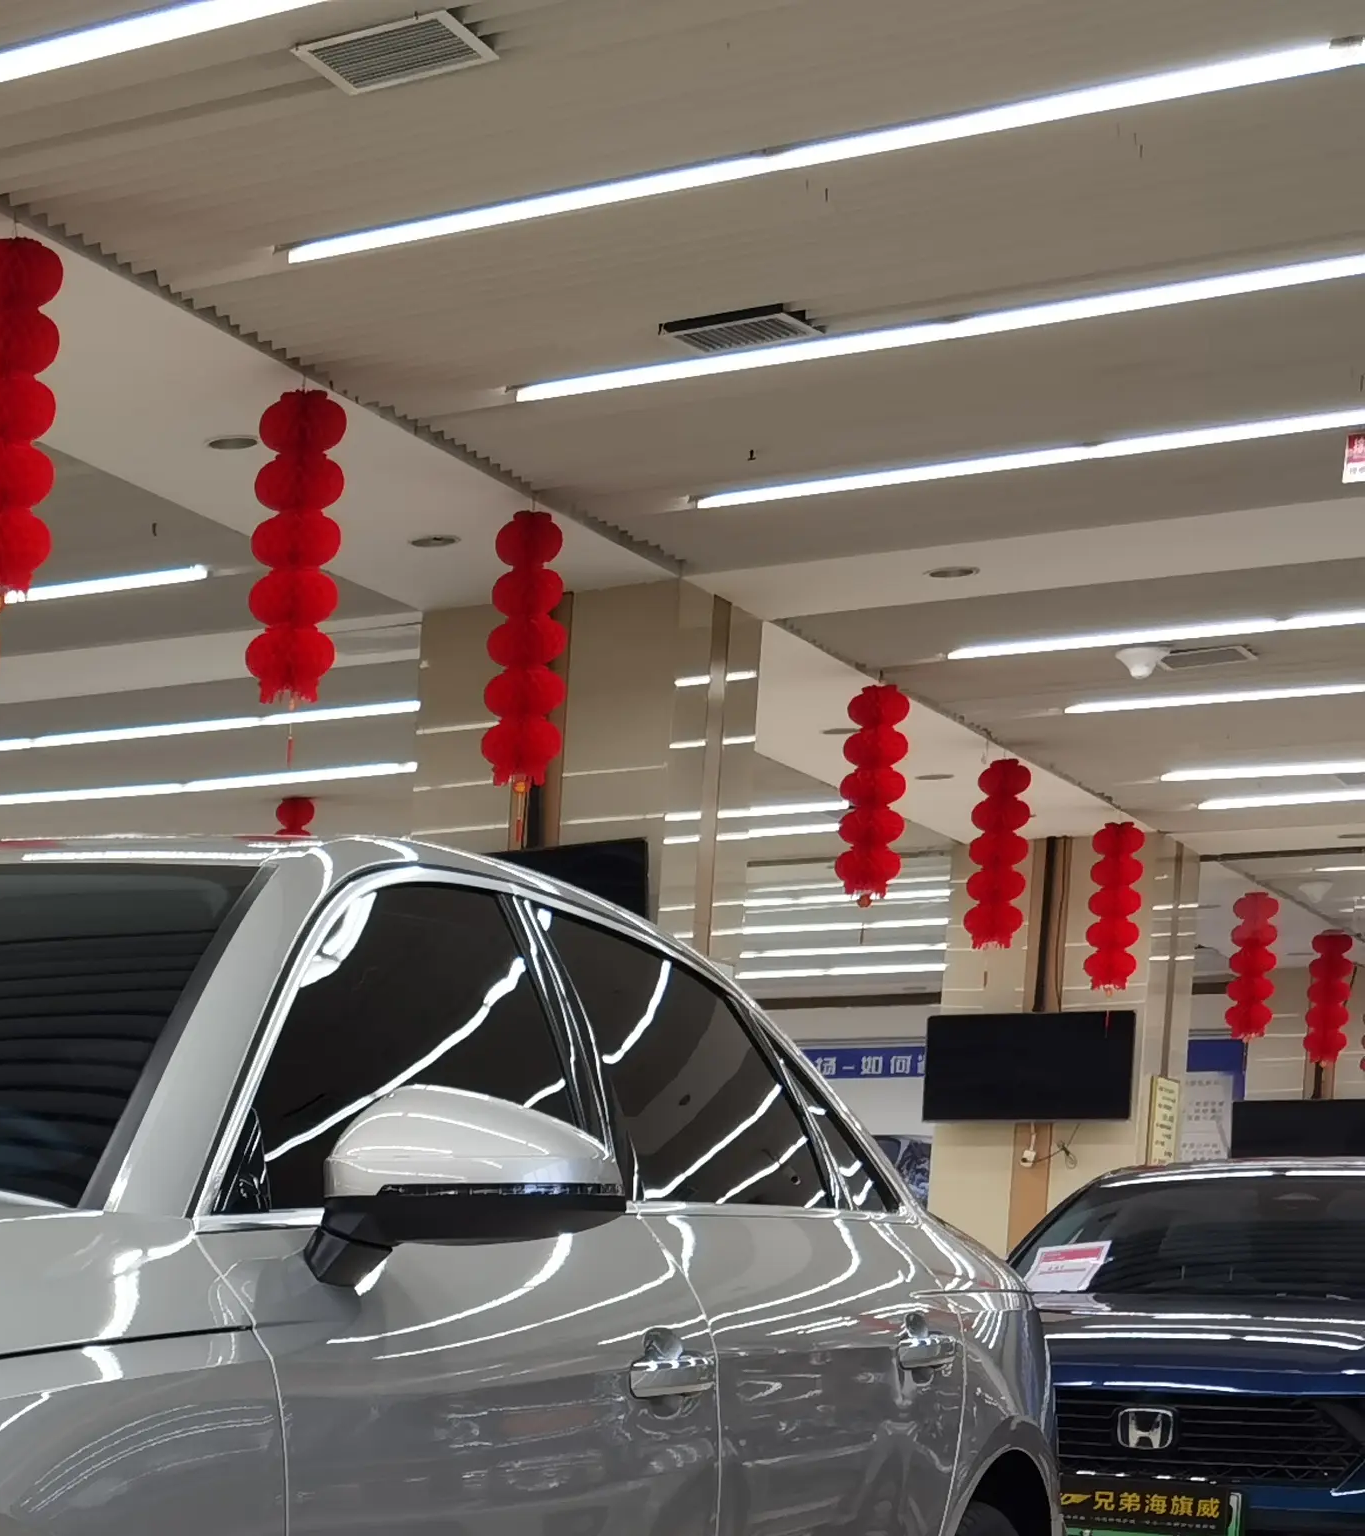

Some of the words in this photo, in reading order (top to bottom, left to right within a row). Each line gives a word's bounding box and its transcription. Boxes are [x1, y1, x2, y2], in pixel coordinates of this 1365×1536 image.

[1092, 1490, 1221, 1519] 兄弟海旗威
